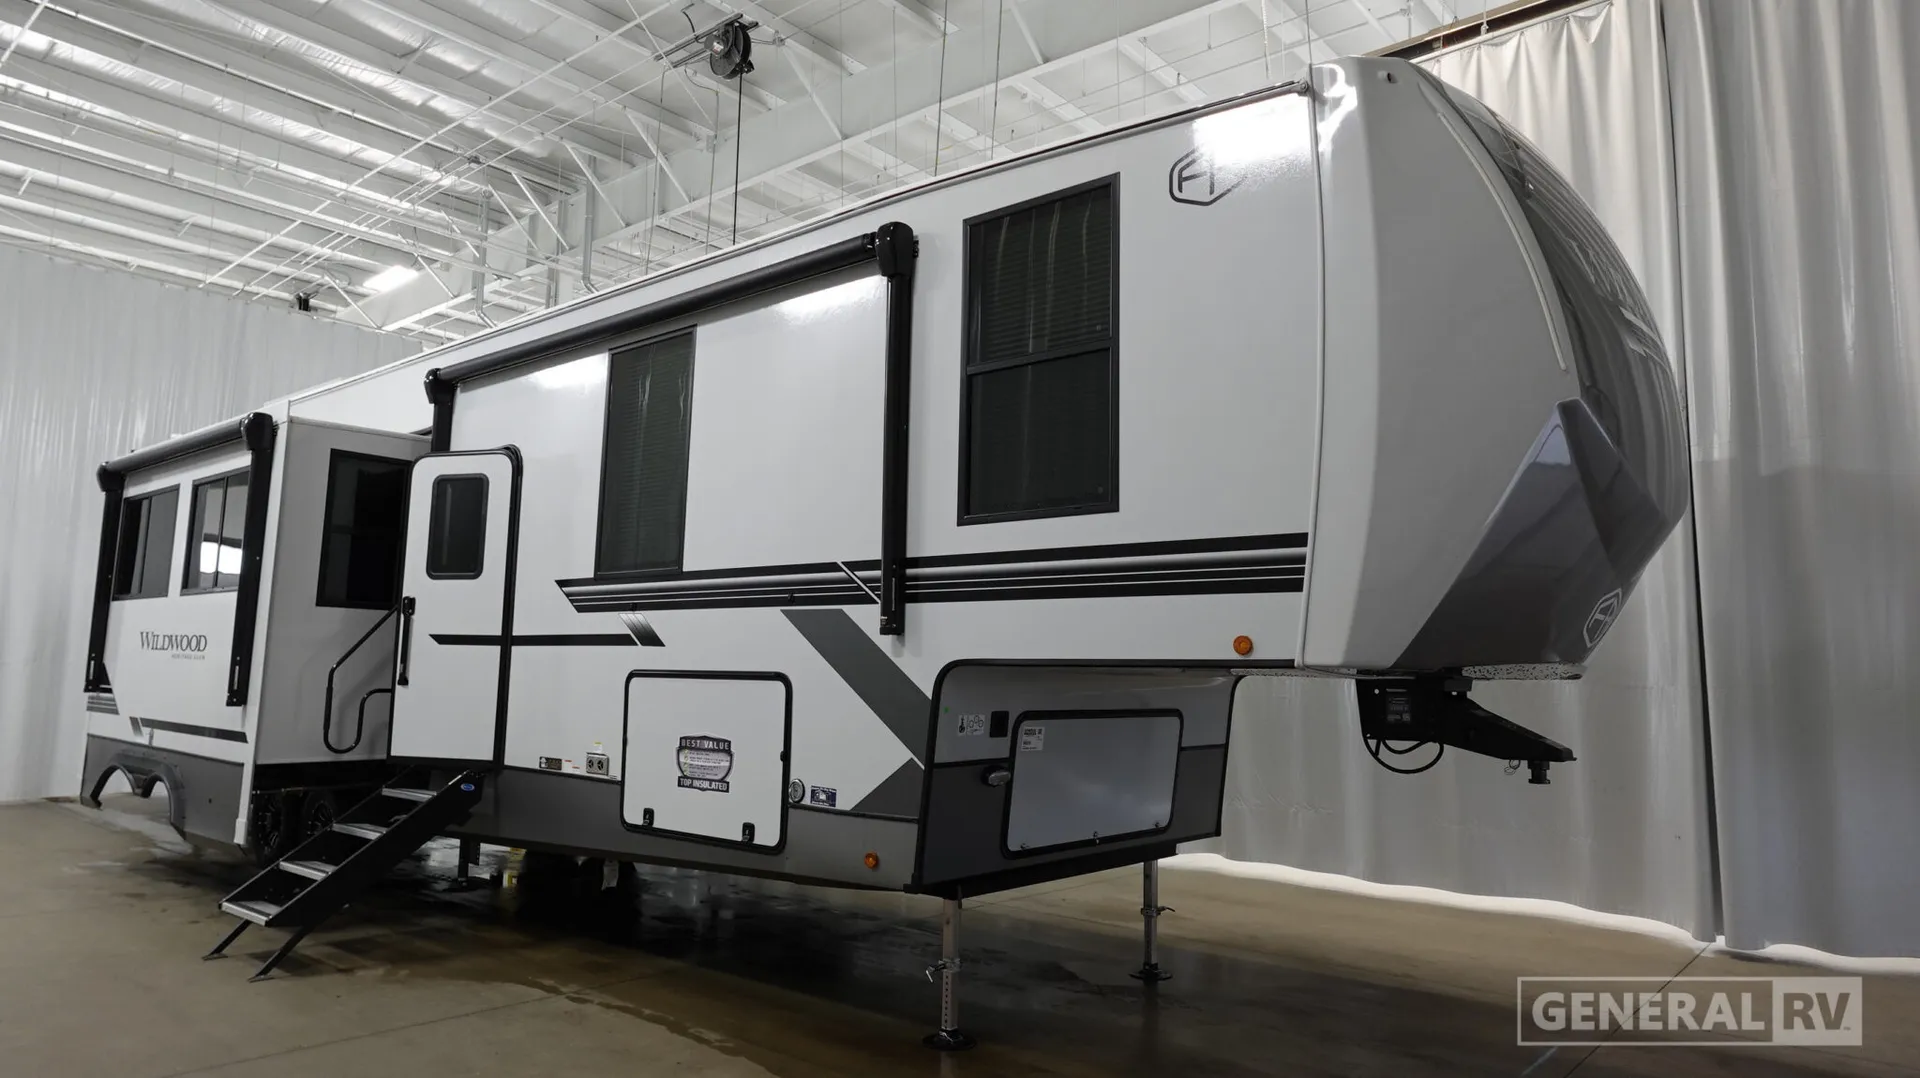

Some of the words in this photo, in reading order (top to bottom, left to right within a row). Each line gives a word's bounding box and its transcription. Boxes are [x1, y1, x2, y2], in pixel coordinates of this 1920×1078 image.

[140, 631, 208, 652] WILDWOOD
[681, 738, 700, 748] BEST
[704, 740, 730, 750] VALUE
[680, 778, 692, 787] TOP
[692, 779, 728, 791] INSULATED
